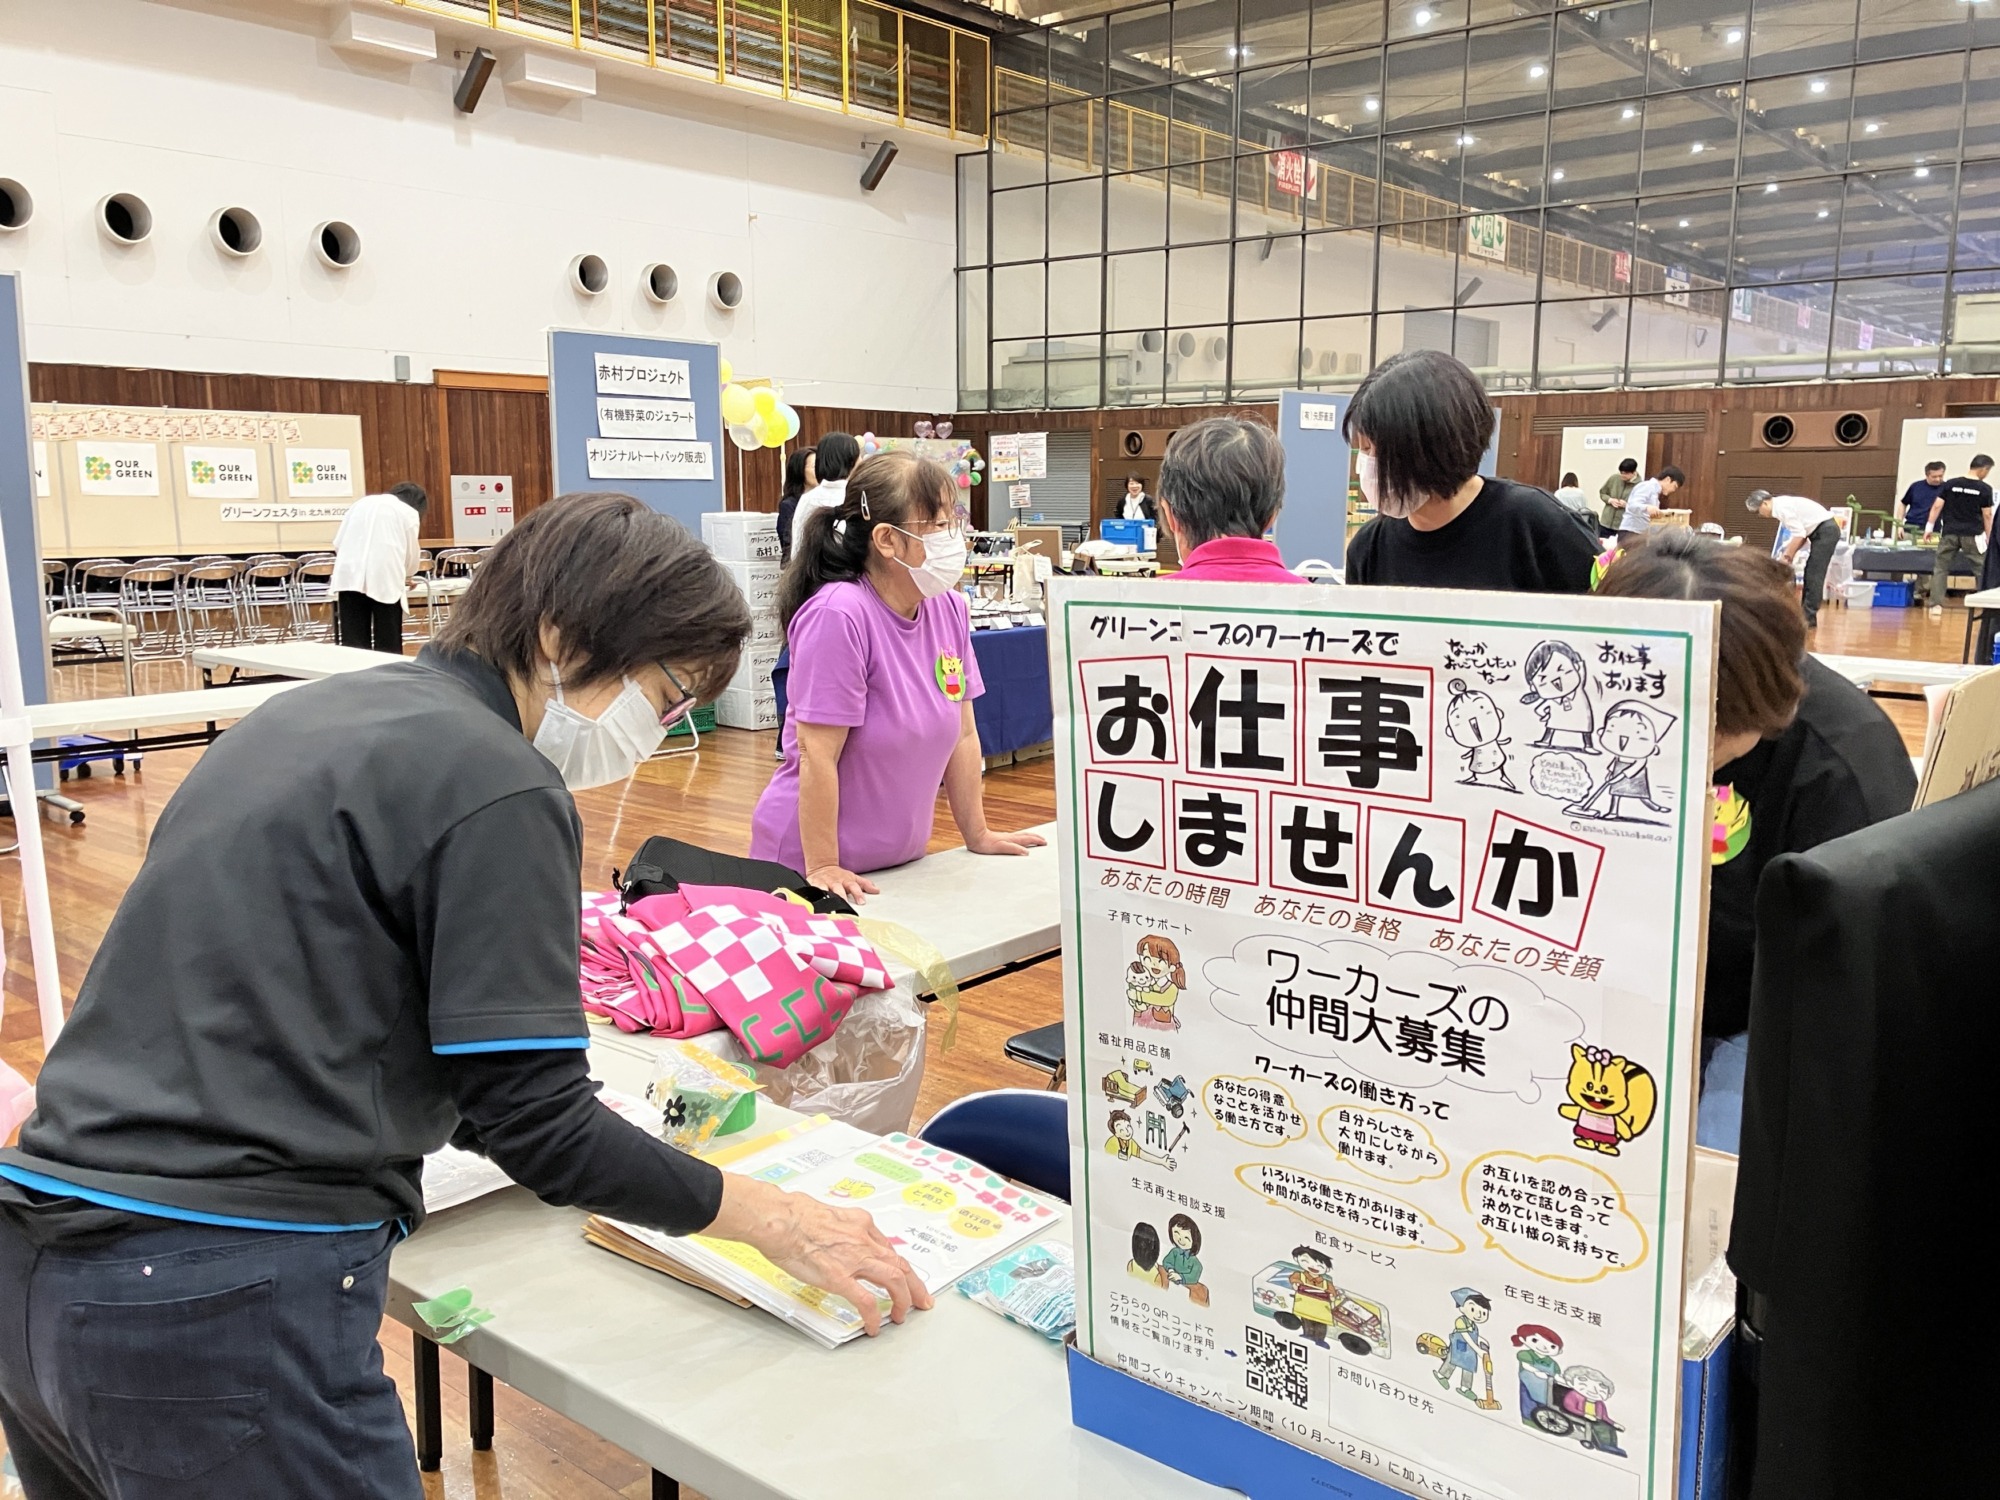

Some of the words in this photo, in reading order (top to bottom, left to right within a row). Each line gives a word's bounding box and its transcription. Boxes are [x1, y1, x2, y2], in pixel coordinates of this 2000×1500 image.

[598, 364, 685, 385] 赤村プロジェクト
[600, 407, 694, 423] (有機野菜のジェラート
[115, 459, 139, 469] OUR
[116, 469, 153, 478] GREEN
[218, 464, 241, 472] OUR
[219, 473, 253, 482] GREEN
[316, 464, 337, 472] OUR
[317, 473, 347, 481] GREEN
[1595, 640, 1652, 669] お仕事
[1602, 670, 1668, 699] あります
[1096, 665, 1425, 789] お仕事
[1097, 780, 1580, 918] しませんか
[1100, 867, 1231, 909] あなたの時間
[1107, 909, 1193, 936] 子育てサポート
[1253, 894, 1403, 942] あなたの資格
[1430, 928, 1605, 982] あなたの笑顔
[1267, 949, 1510, 1031] ワーカーズの
[1098, 1032, 1171, 1060] 福祉用品店舗
[1266, 985, 1486, 1077] 仲間大募集
[1213, 1078, 1285, 1107] あなたの得意
[1254, 1055, 1450, 1121] ワーカーズの働き方って
[1213, 1093, 1302, 1126] なことを活かせ
[1214, 1108, 1292, 1139] る働き方です。
[1339, 1109, 1415, 1142] 自分らしさを
[1338, 1126, 1438, 1165] 大切にしながら
[1338, 1140, 1394, 1170] 働けます。
[911, 1157, 1032, 1223] ワーカー募集中
[921, 1183, 953, 1198] 子育て
[1131, 1177, 1226, 1219] 生活再生相談支援
[1262, 1165, 1424, 1228] いろいろな働き方があります。
[1482, 1164, 1615, 1210] お互いを認め合って
[1482, 1180, 1611, 1226] みんなで話し合って
[964, 1222, 981, 1232] OK
[1262, 1180, 1425, 1244] 仲間があなたを待っています。
[1482, 1195, 1589, 1239] 決めていきます。
[911, 1243, 931, 1254] UP
[1315, 1230, 1397, 1269] 配食サービス
[1481, 1214, 1626, 1268] お互い様の気持ちで。
[1504, 1284, 1602, 1327] 在宅生活支援
[1109, 1303, 1215, 1350] グリーンコープの採用
[1109, 1315, 1210, 1361] 情報をご覧頂けます。
[1336, 1365, 1435, 1415] お問い合わせ先
